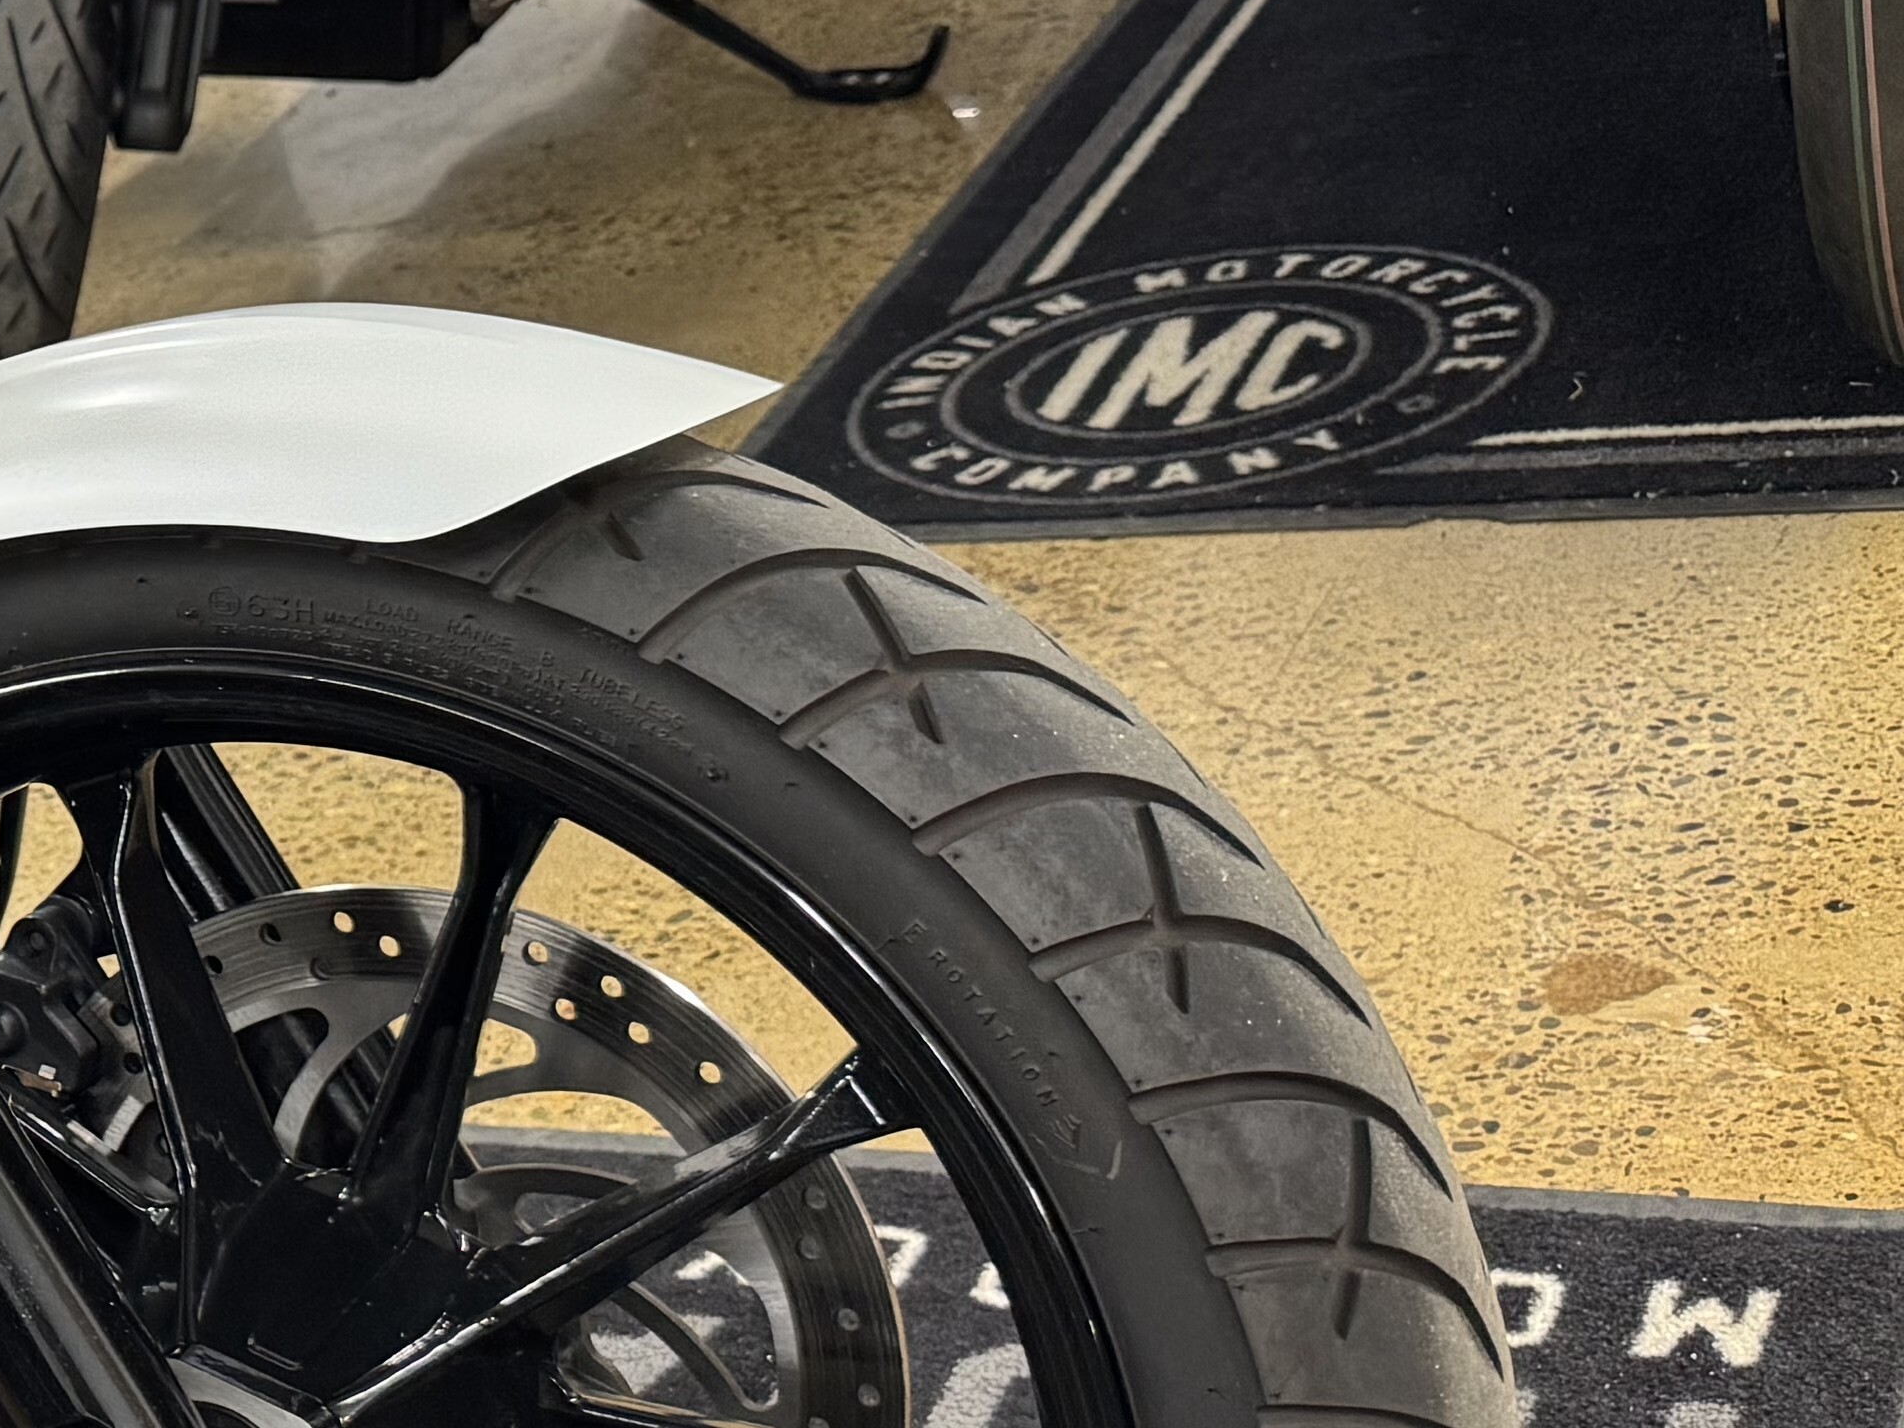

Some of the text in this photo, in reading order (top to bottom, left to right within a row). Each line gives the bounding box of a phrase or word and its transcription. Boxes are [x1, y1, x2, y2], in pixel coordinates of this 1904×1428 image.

[877, 252, 1523, 410] INDIAN MOTORCYCLE
[1037, 309, 1347, 429] IMC
[909, 427, 1343, 493] COMPANY
[928, 944, 1059, 1108] ROTATION
